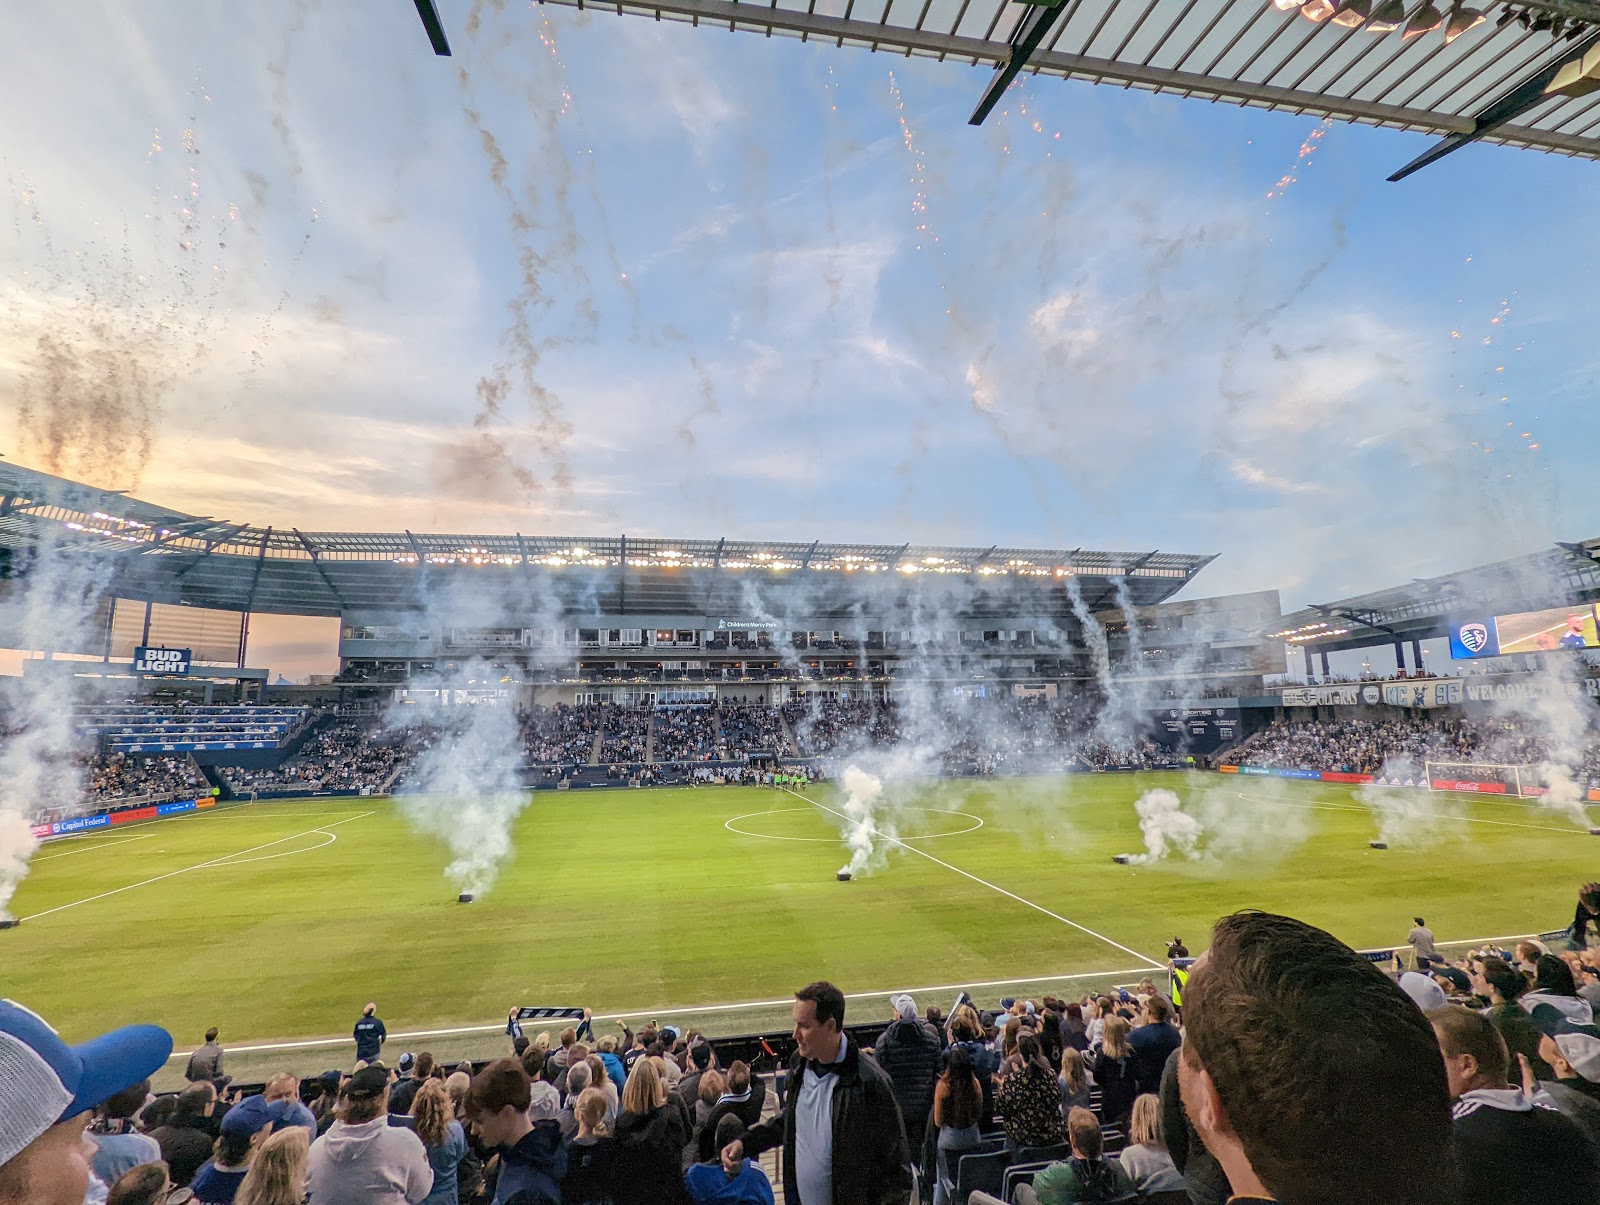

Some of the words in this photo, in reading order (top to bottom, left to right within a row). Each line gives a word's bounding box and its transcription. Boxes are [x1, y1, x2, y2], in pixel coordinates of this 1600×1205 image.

[145, 650, 182, 662] BUD
[136, 660, 188, 672] LIGHT
[1386, 686, 1408, 706] KC
[1435, 683, 1461, 705] 96
[61, 818, 84, 831] Capitol
[85, 816, 106, 826] Federal
